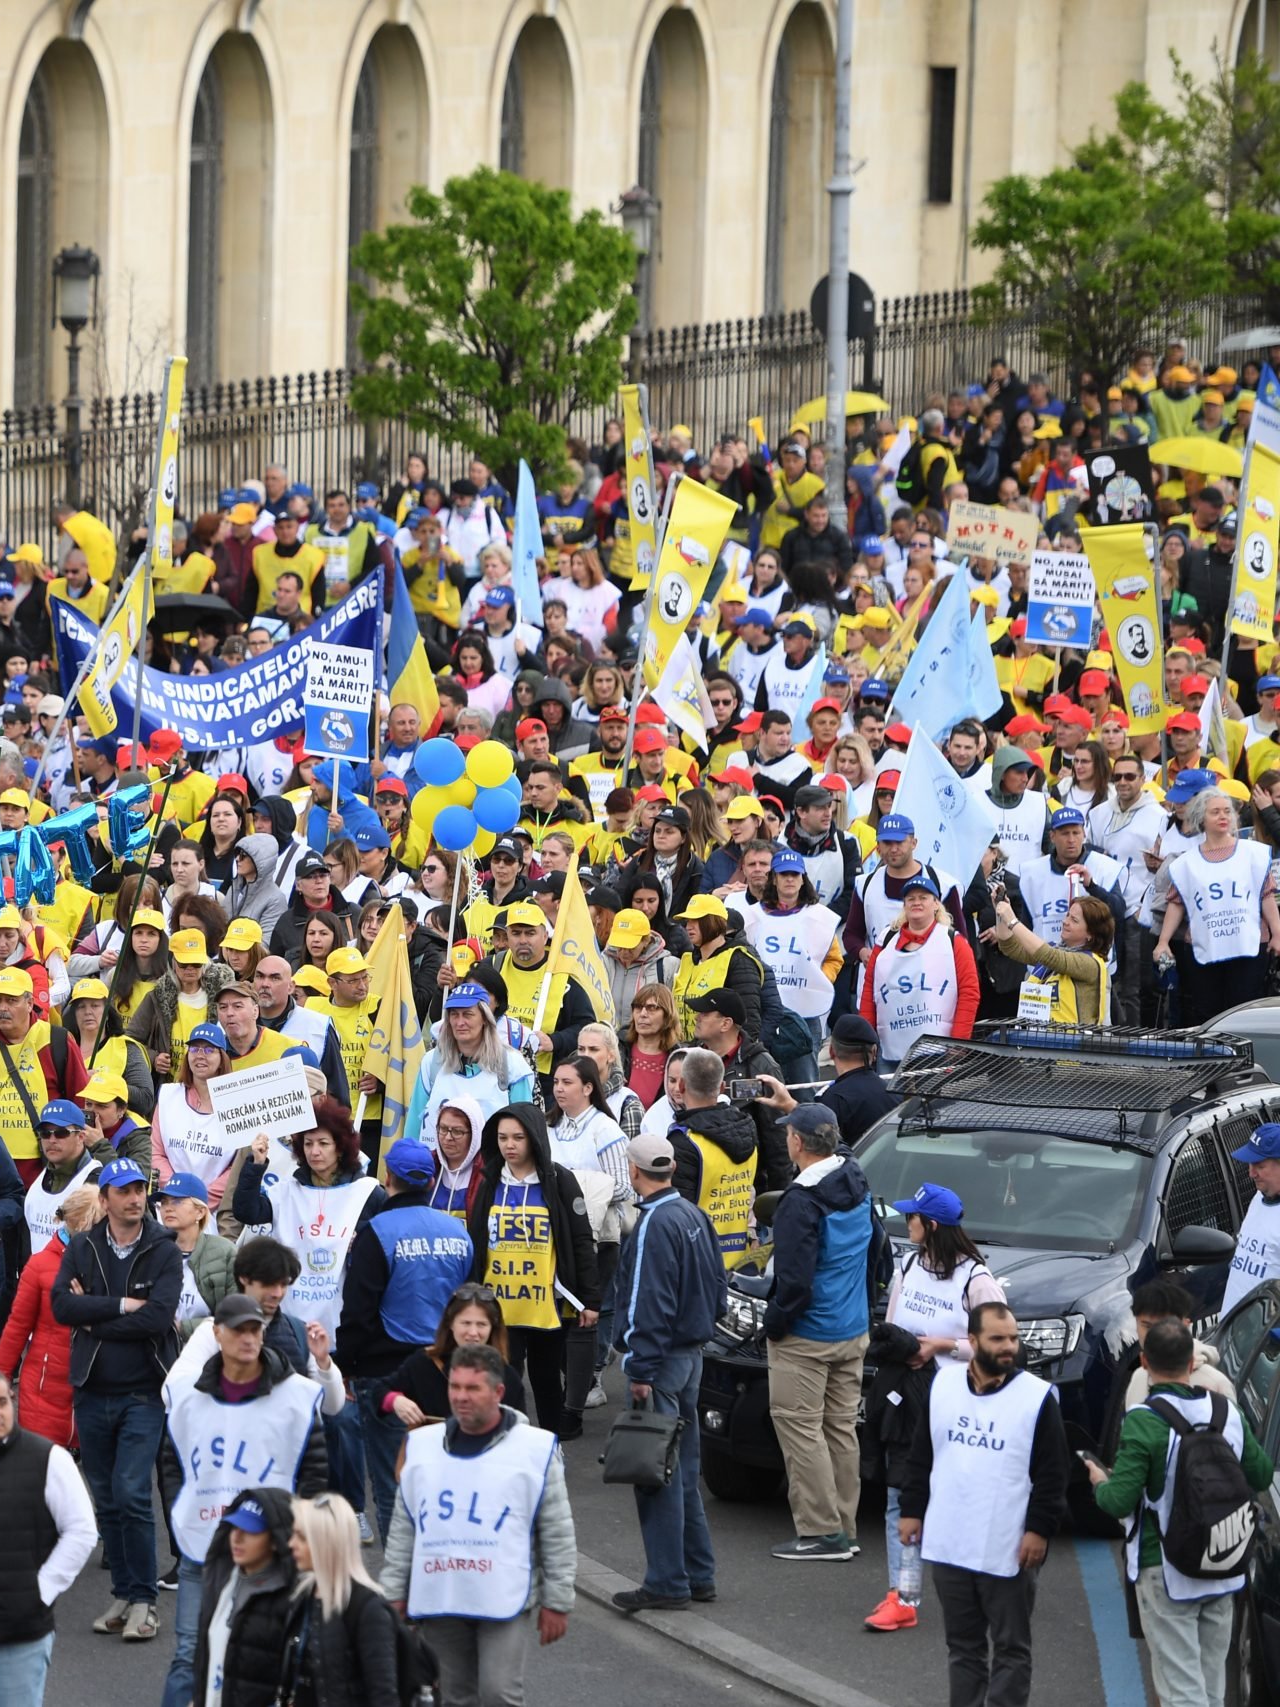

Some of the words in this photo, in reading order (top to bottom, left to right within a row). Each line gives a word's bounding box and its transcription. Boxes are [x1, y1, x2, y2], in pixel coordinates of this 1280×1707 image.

[1045, 568, 1082, 578] MUSAI
[162, 635, 313, 702] SINDICATELOR
[321, 579, 378, 641] LIBERE
[312, 651, 331, 662] NO,
[336, 654, 367, 667] AMU-I
[322, 665, 359, 679] MUSAI
[310, 676, 329, 687] SĂ
[333, 677, 369, 694] MĂRIȚI
[310, 689, 367, 706] SALARUL!
[329, 712, 344, 720] SIP
[328, 742, 346, 751] Sibiu
[996, 832, 1029, 841] ANCEA
[1194, 881, 1251, 911] FSLI
[880, 972, 949, 1004] FSLI
[213, 1081, 238, 1093] SINDICATUL
[256, 1070, 279, 1082] PRAHOVEI
[218, 1103, 256, 1122] ÎNCERCĂM
[257, 1099, 267, 1112] SĂ
[268, 1090, 307, 1109] REZISTĂM,
[2, 1119, 30, 1129] HARE
[225, 1116, 261, 1135] ROMÂNIA
[262, 1112, 272, 1124] SĂ
[273, 1104, 306, 1122] SALVĂM.
[190, 1141, 223, 1157] VITEAZUL
[299, 1224, 347, 1241] FSLI
[498, 1214, 550, 1241] FSE
[491, 1260, 537, 1276] S.I.P.
[1231, 1256, 1268, 1279] aslui
[190, 1436, 275, 1483] FSLI
[419, 1489, 511, 1533] FSLI
[1210, 1502, 1255, 1556] NIKE
[424, 1555, 492, 1575] CĂLĂRAȘI
